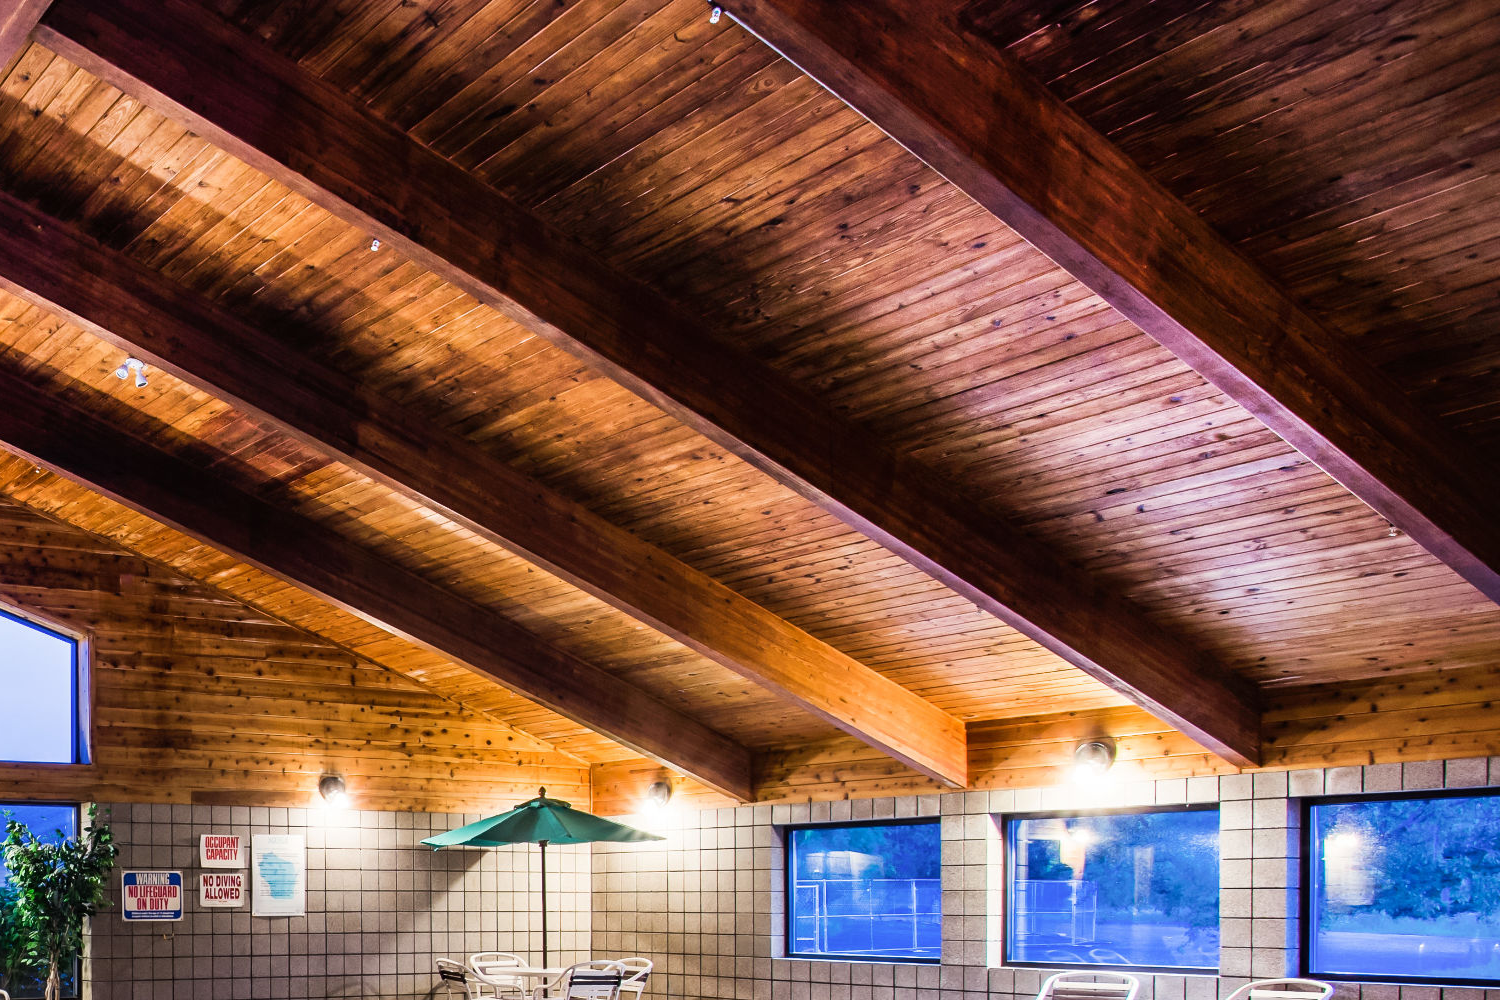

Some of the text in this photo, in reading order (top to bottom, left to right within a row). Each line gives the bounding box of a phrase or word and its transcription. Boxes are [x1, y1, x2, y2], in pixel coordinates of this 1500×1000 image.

[205, 836, 240, 849] OCCUPANT
[206, 848, 238, 861] CAPACITY
[135, 873, 170, 885] WARNING
[203, 875, 242, 887] NO DIVING
[128, 885, 177, 898] NO LIFEGUARD
[205, 887, 240, 900] ALLOWED
[137, 897, 169, 910] ON DUTY
